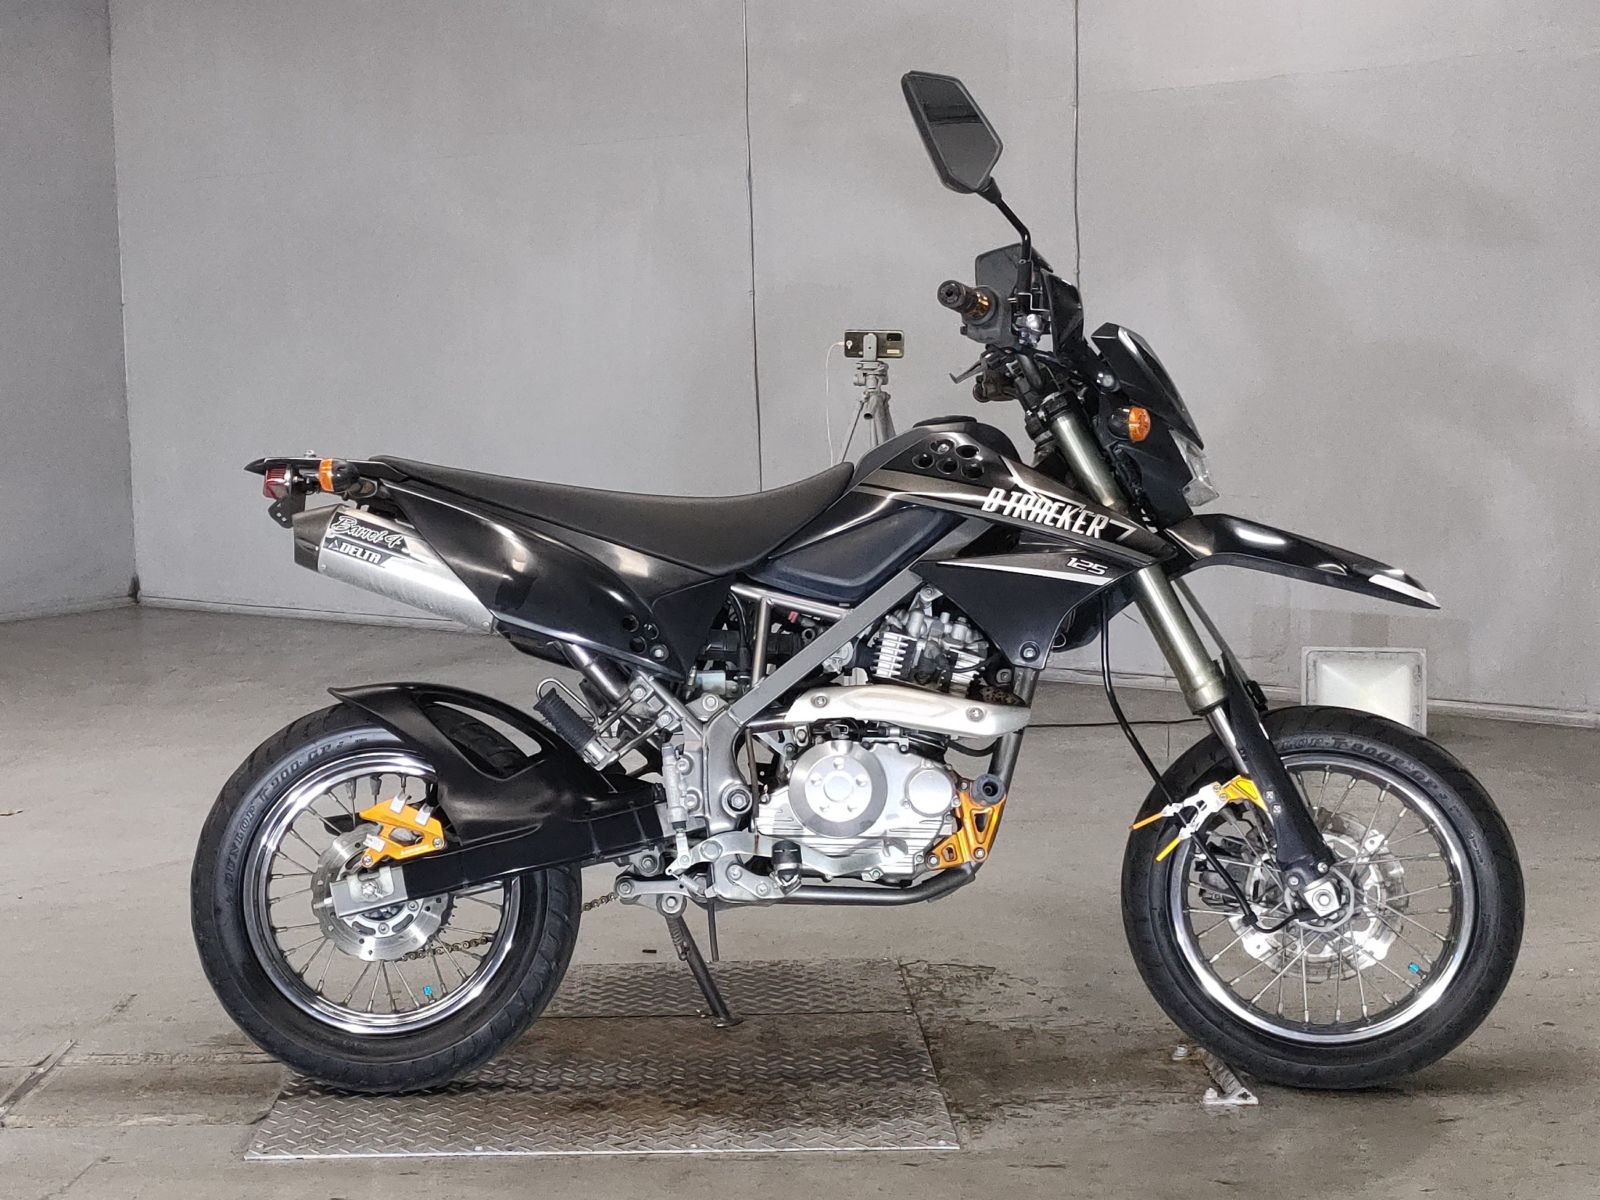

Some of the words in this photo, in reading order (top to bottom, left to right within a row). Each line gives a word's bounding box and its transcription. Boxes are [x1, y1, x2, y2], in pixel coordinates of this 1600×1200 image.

[981, 487, 1109, 539] D-TRACKER
[339, 541, 382, 564] DELTA
[1066, 557, 1108, 575] 125
[224, 805, 256, 886] DUNLOP
